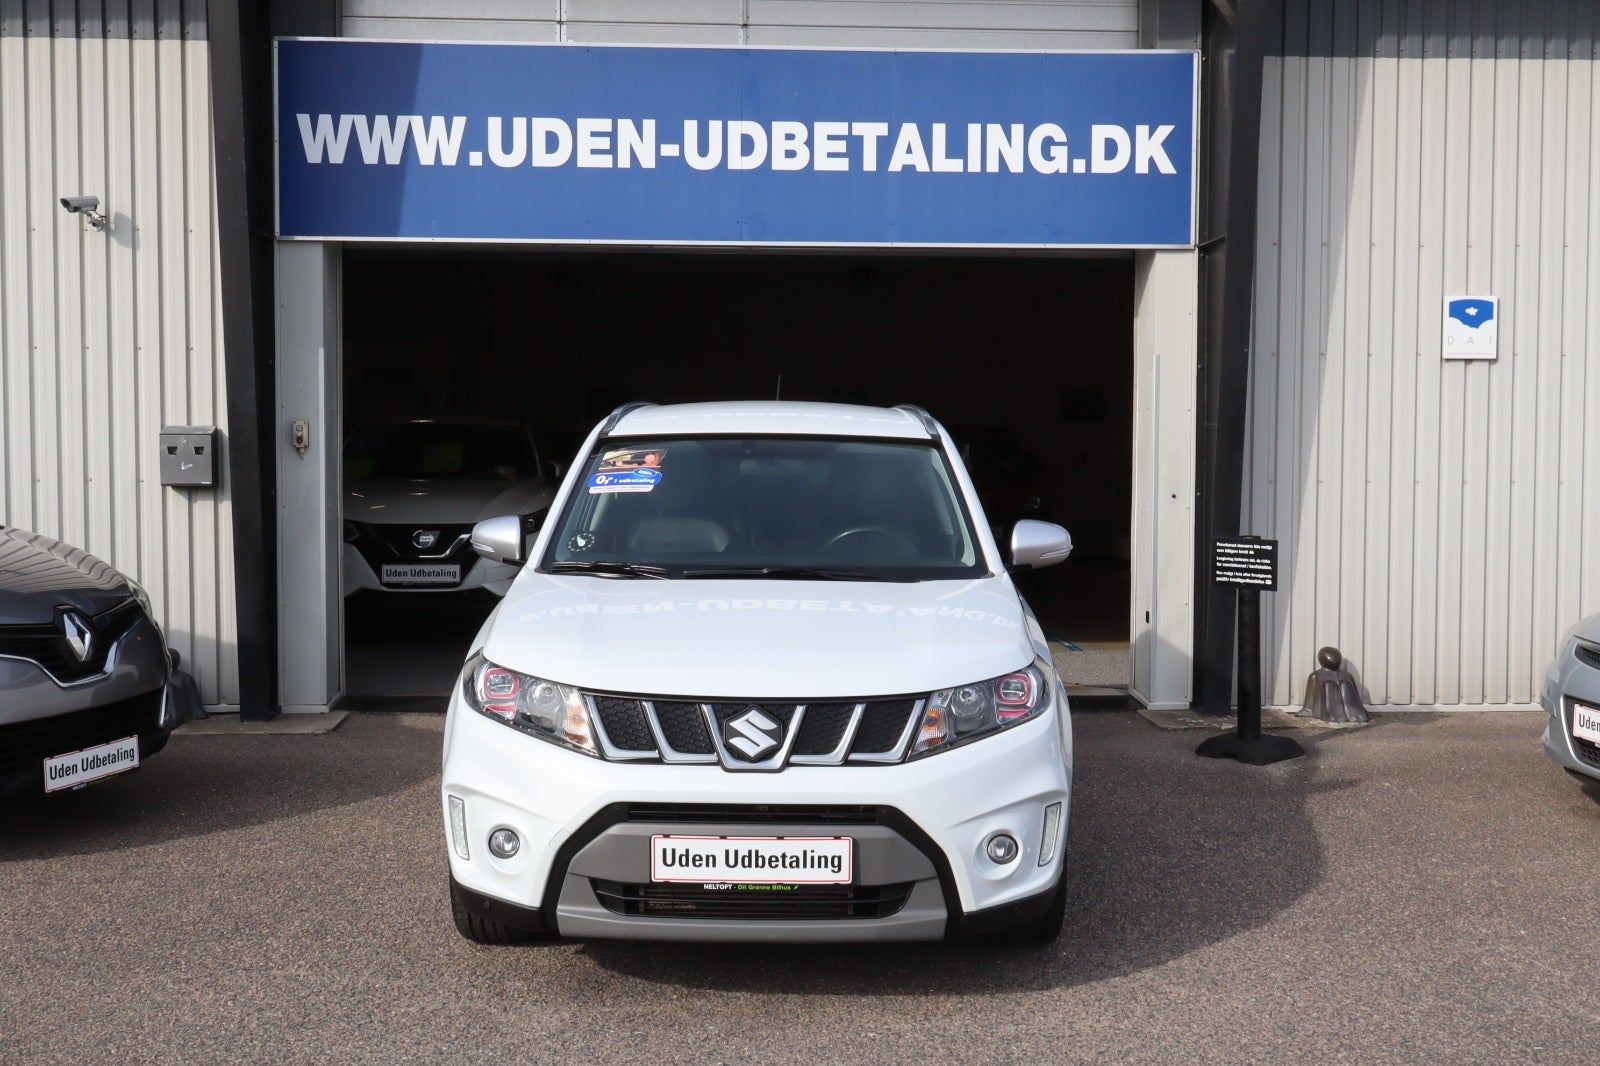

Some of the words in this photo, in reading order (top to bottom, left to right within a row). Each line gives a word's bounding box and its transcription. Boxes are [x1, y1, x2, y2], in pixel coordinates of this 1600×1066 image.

[296, 113, 1177, 175] WWW.UDEN-UDBETALING.DK
[386, 569, 408, 578] Uden
[410, 569, 457, 579] Udbetaling
[49, 763, 78, 781] Uden
[81, 747, 135, 772] Udbetaling
[662, 847, 717, 868] Uden
[724, 849, 842, 874] Udbetaling
[772, 884, 791, 892] Bilhus
